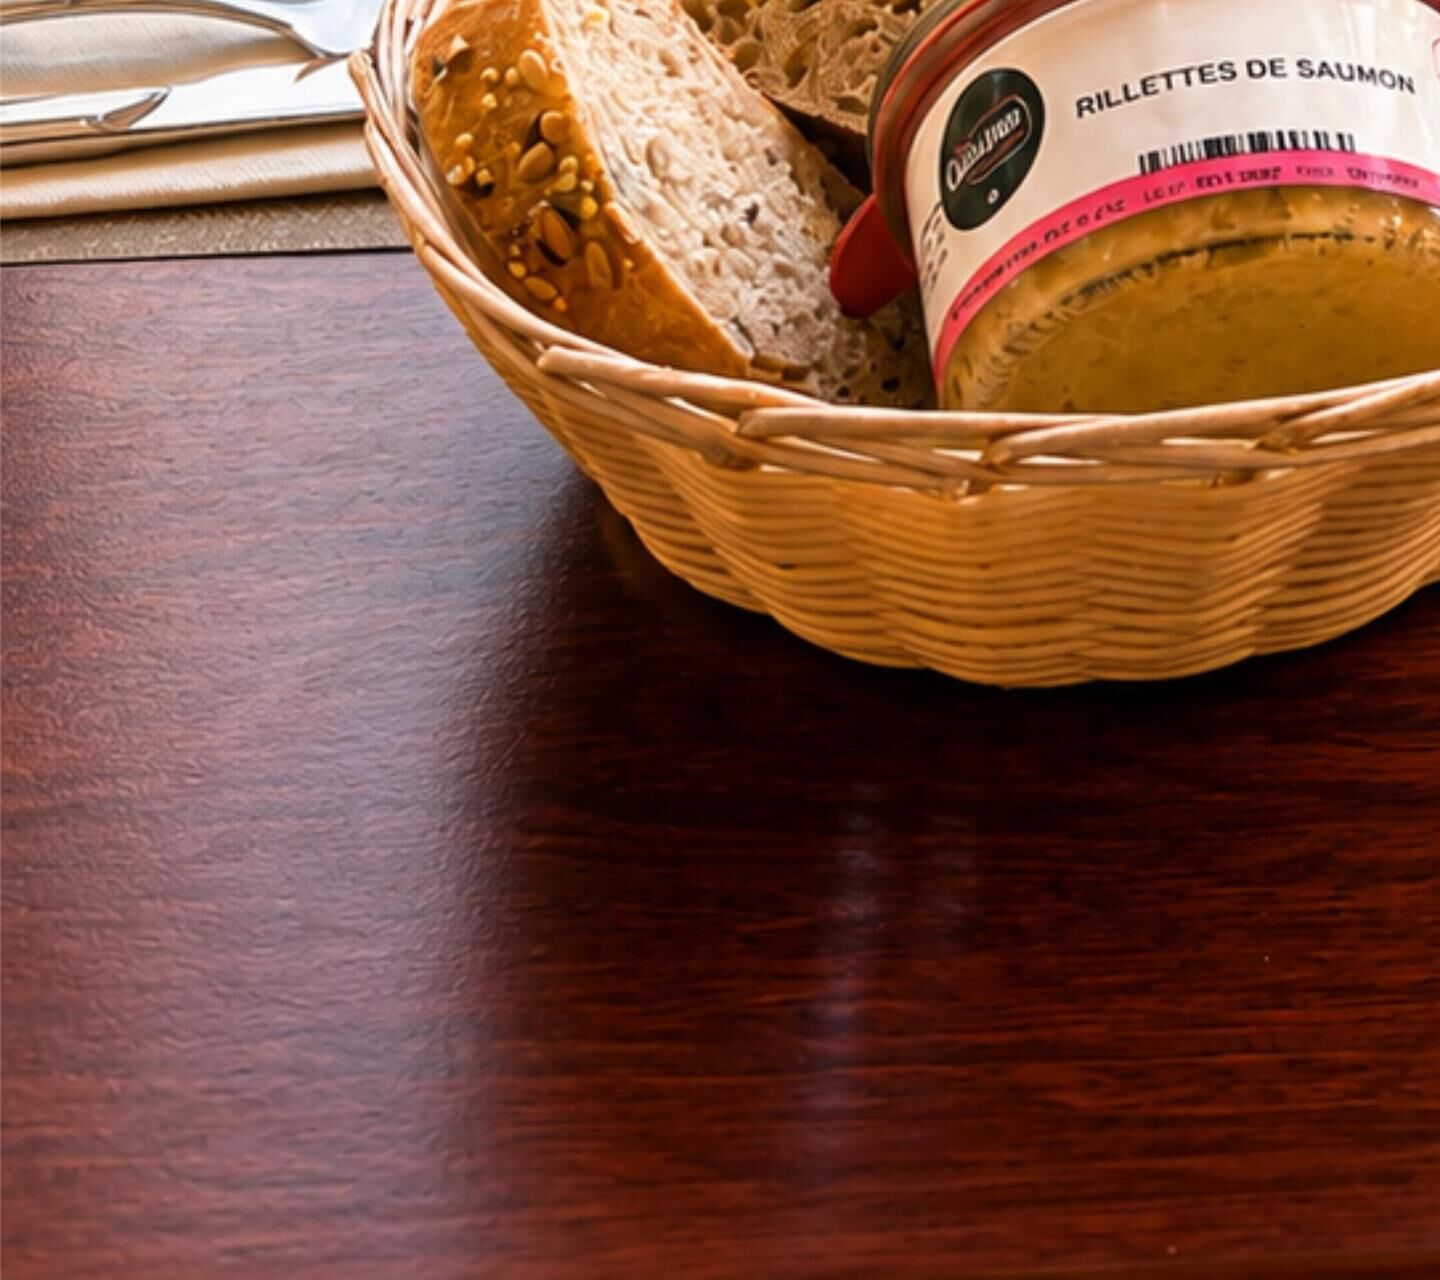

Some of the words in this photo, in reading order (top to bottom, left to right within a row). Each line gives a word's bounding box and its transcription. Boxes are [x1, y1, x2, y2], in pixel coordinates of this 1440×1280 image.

[1075, 59, 1238, 120] RILLETTES
[1245, 56, 1288, 82] DE
[1296, 57, 1418, 96] SAUMON
